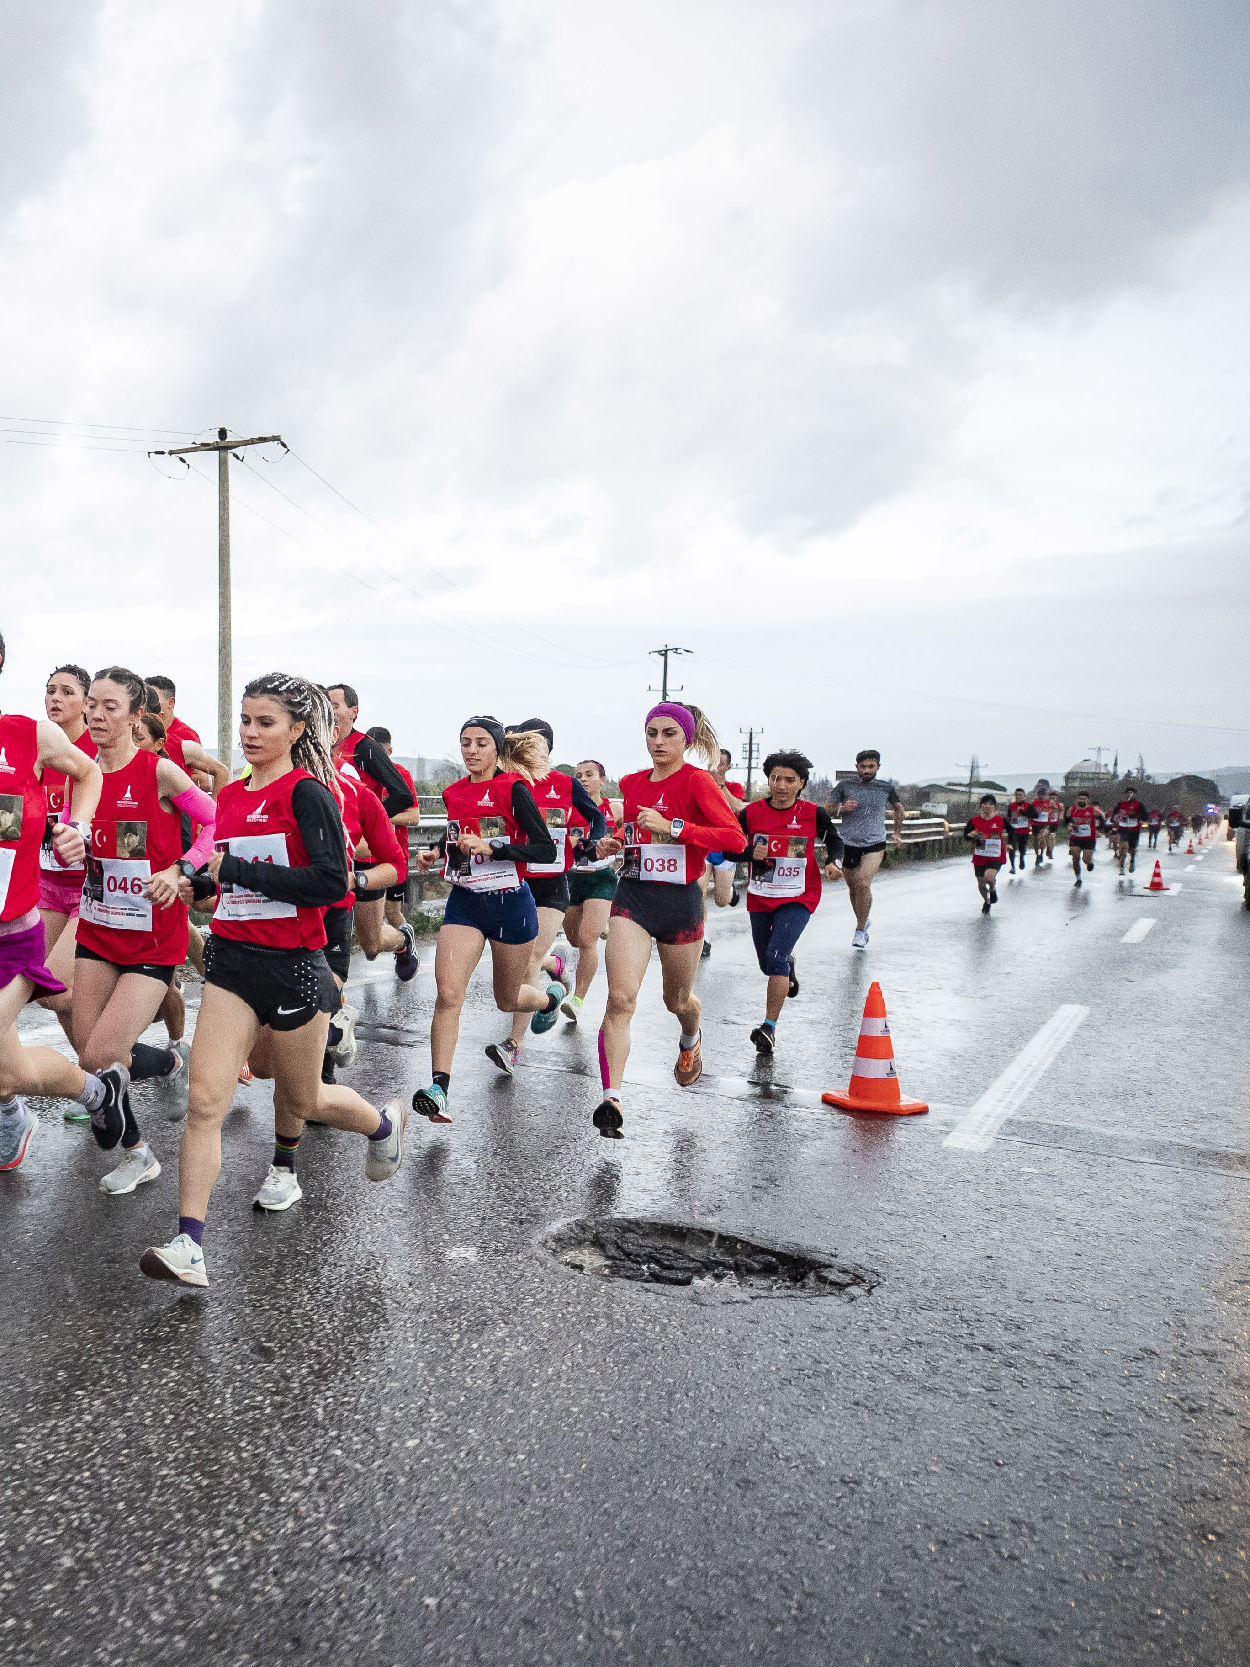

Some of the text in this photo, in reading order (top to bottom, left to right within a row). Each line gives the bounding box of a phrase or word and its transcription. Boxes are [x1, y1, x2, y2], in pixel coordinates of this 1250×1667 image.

[644, 858, 678, 873] 038
[777, 867, 800, 877] 035
[106, 875, 143, 895] 046
